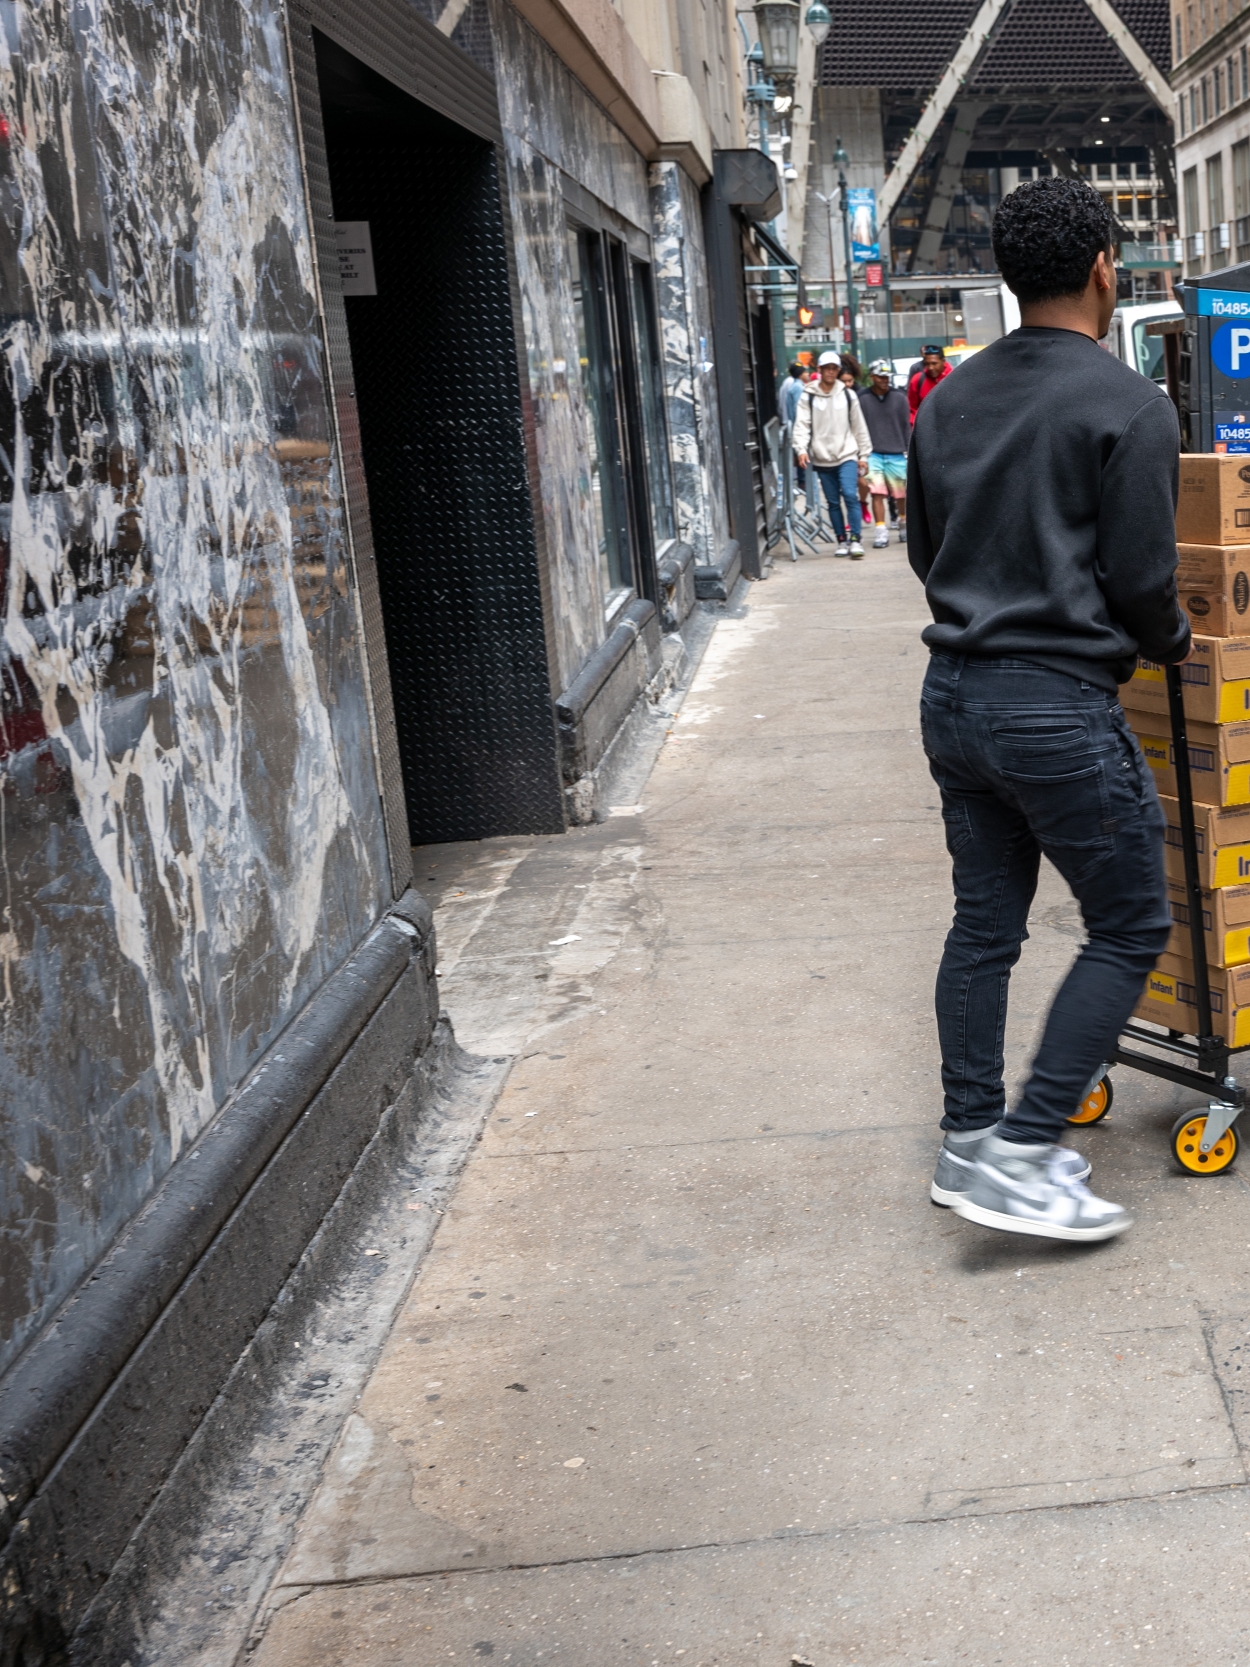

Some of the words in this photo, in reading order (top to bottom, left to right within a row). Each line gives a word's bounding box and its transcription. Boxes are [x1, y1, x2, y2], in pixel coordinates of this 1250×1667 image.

[1237, 573, 1246, 611] Pedialyte
[1144, 745, 1166, 761] Infant
[1150, 978, 1174, 996] Infant
